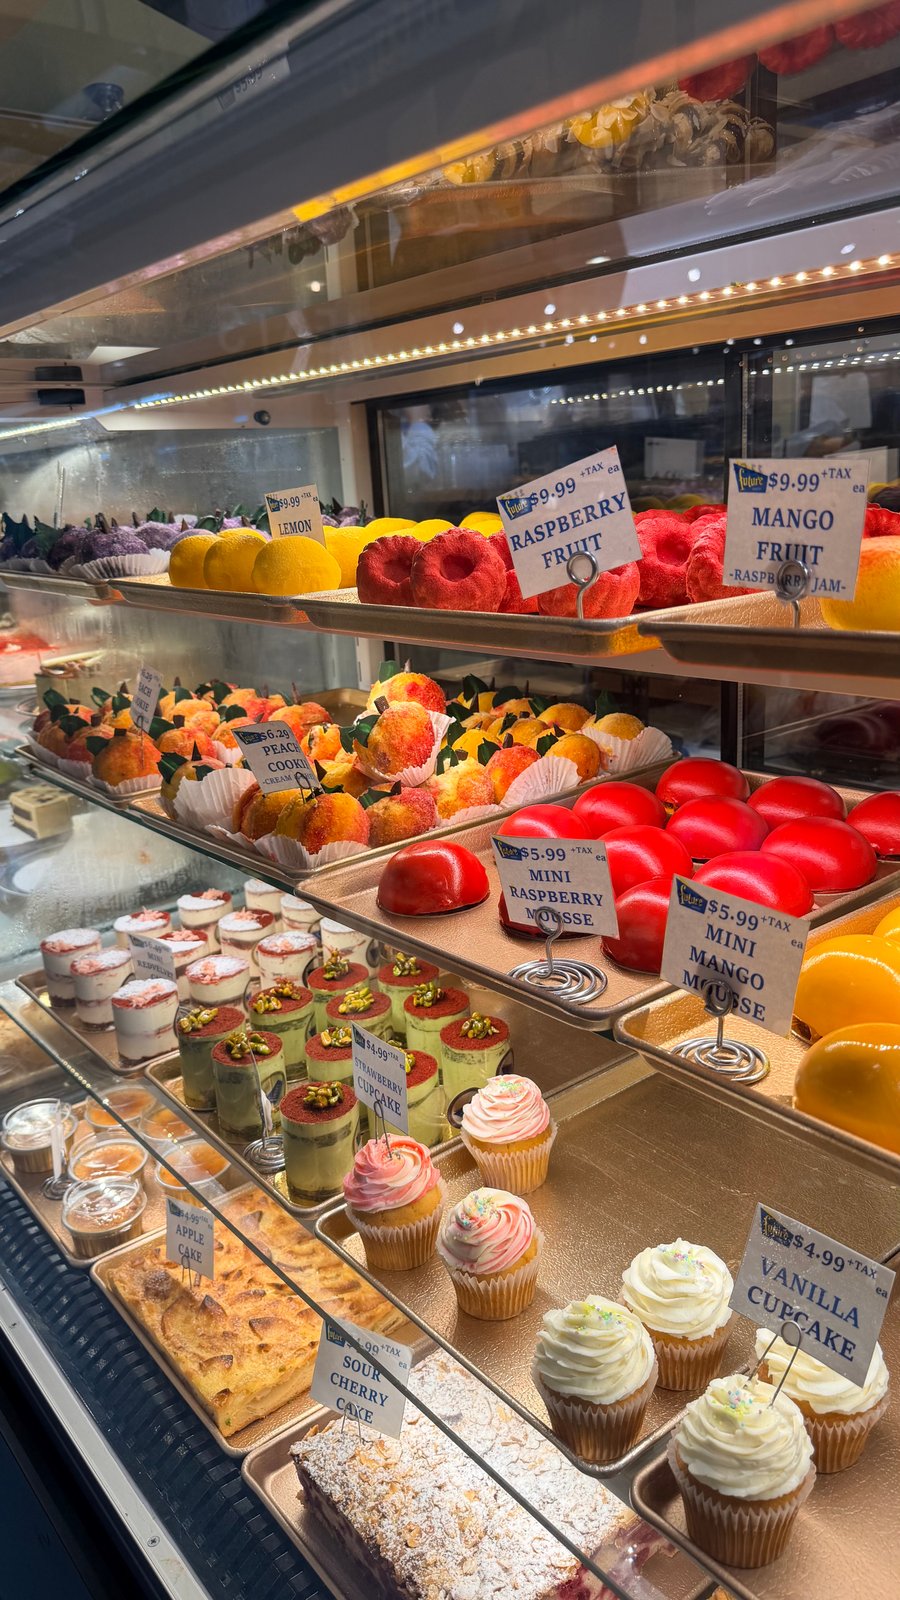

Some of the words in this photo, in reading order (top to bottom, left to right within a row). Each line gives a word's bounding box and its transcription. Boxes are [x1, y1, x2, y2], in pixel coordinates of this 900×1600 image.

[530, 478, 576, 507] $9.99
[580, 462, 604, 477] +TAX
[607, 464, 620, 475] ea
[768, 473, 820, 492] $9.99
[822, 468, 852, 479] +TAX
[852, 484, 865, 493] ea
[280, 496, 300, 508] $9.99
[278, 519, 312, 535] LEMON
[509, 492, 626, 551] RASPBERRY
[751, 507, 834, 530] MANGO
[756, 541, 823, 565] FRUIT
[729, 568, 808, 587] -RASPBRR
[260, 729, 289, 741] $6.29
[520, 847, 566, 861] $5.99
[595, 854, 606, 862] ea
[529, 869, 571, 883] MINI
[509, 885, 603, 907] RASPBERRY
[708, 900, 758, 931] $5.99
[761, 915, 791, 933] +TAX
[791, 938, 803, 949] ea
[705, 923, 757, 958] MINI
[689, 945, 765, 991] MANGO
[366, 1039, 388, 1062] $4.99
[354, 1056, 403, 1097] STRAWBERRY
[357, 1075, 401, 1116] CUPCAKE
[175, 1224, 205, 1245] APPLE
[178, 1243, 203, 1264] CAKE
[792, 1234, 845, 1273] $4.99
[848, 1259, 877, 1280] +TAX
[875, 1286, 888, 1299] ea
[761, 1255, 860, 1329] VANILLA
[747, 1285, 857, 1362] CUPCAKE
[381, 1344, 401, 1357] +TAX
[342, 1355, 382, 1382] SOUR
[330, 1372, 388, 1407] CHERRY
[336, 1397, 374, 1424] CAKE
